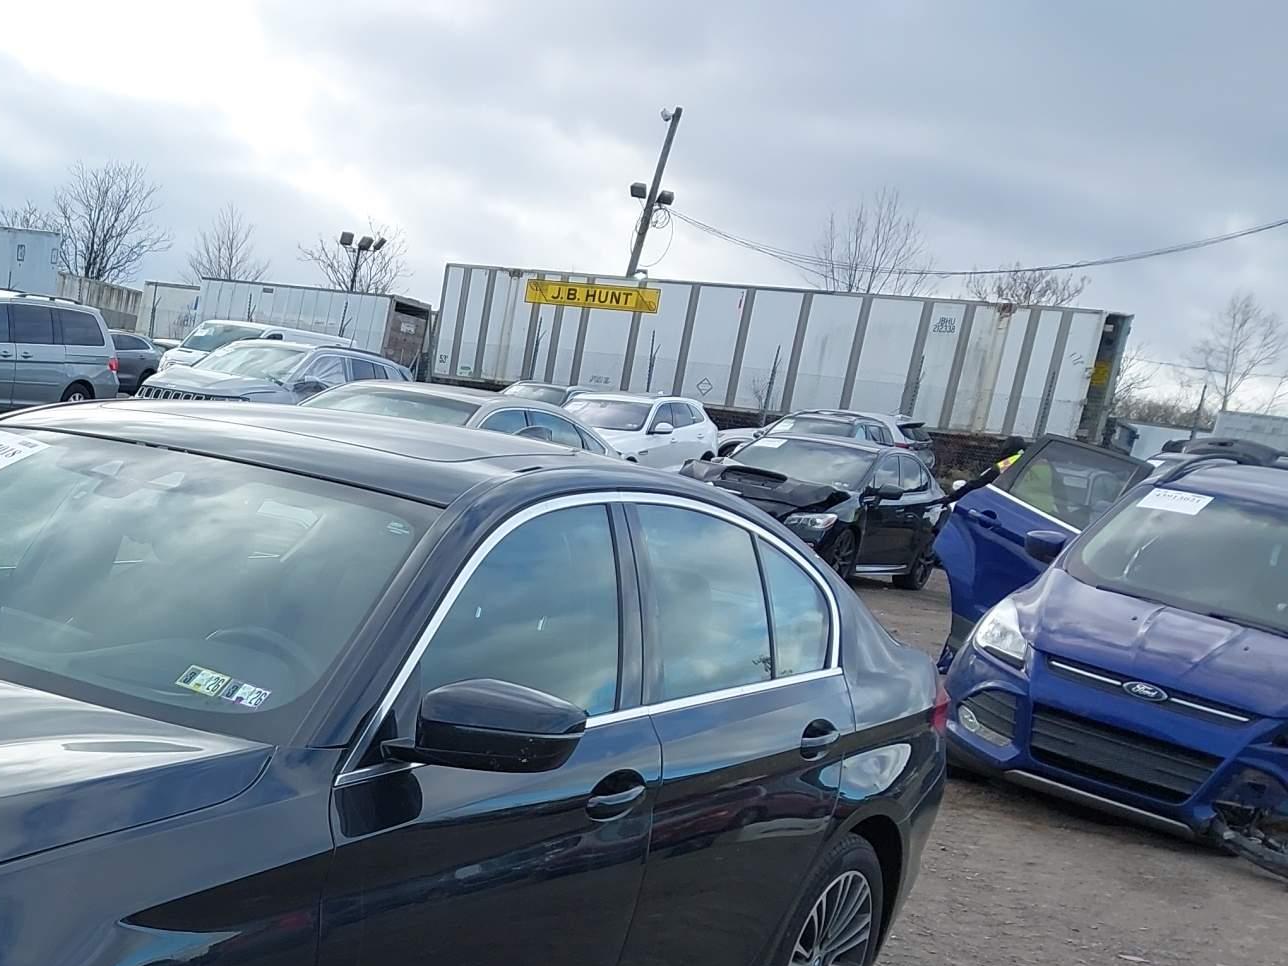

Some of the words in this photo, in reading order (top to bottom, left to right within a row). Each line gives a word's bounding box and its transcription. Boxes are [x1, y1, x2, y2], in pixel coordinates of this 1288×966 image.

[551, 287, 581, 302] J.B.
[585, 288, 633, 306] HUNT
[183, 671, 197, 684] 3
[226, 684, 239, 698] 3
[1131, 683, 1159, 698] Ford
